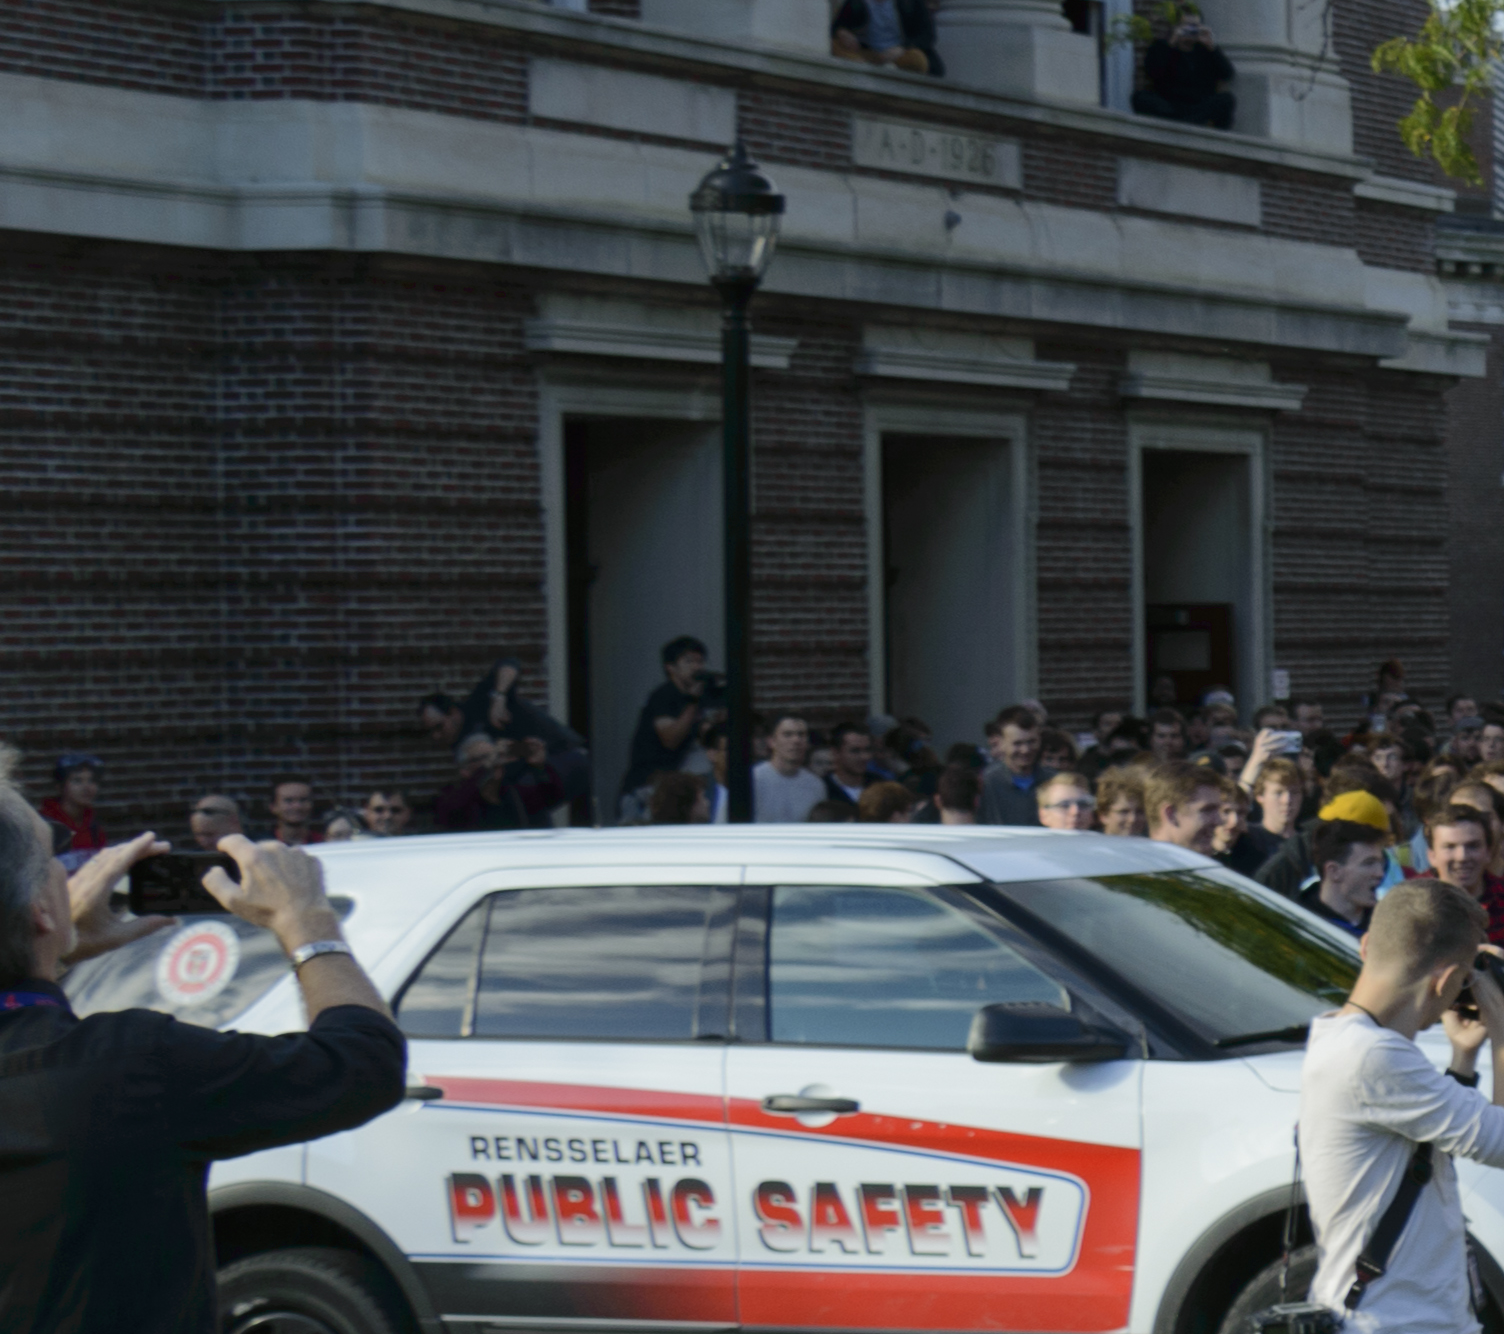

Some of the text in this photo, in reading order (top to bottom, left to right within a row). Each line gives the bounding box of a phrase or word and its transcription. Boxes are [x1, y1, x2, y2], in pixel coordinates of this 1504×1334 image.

[470, 1136, 702, 1168] RENSSELAER
[446, 1172, 1044, 1259] PUBLIC SAFETY
